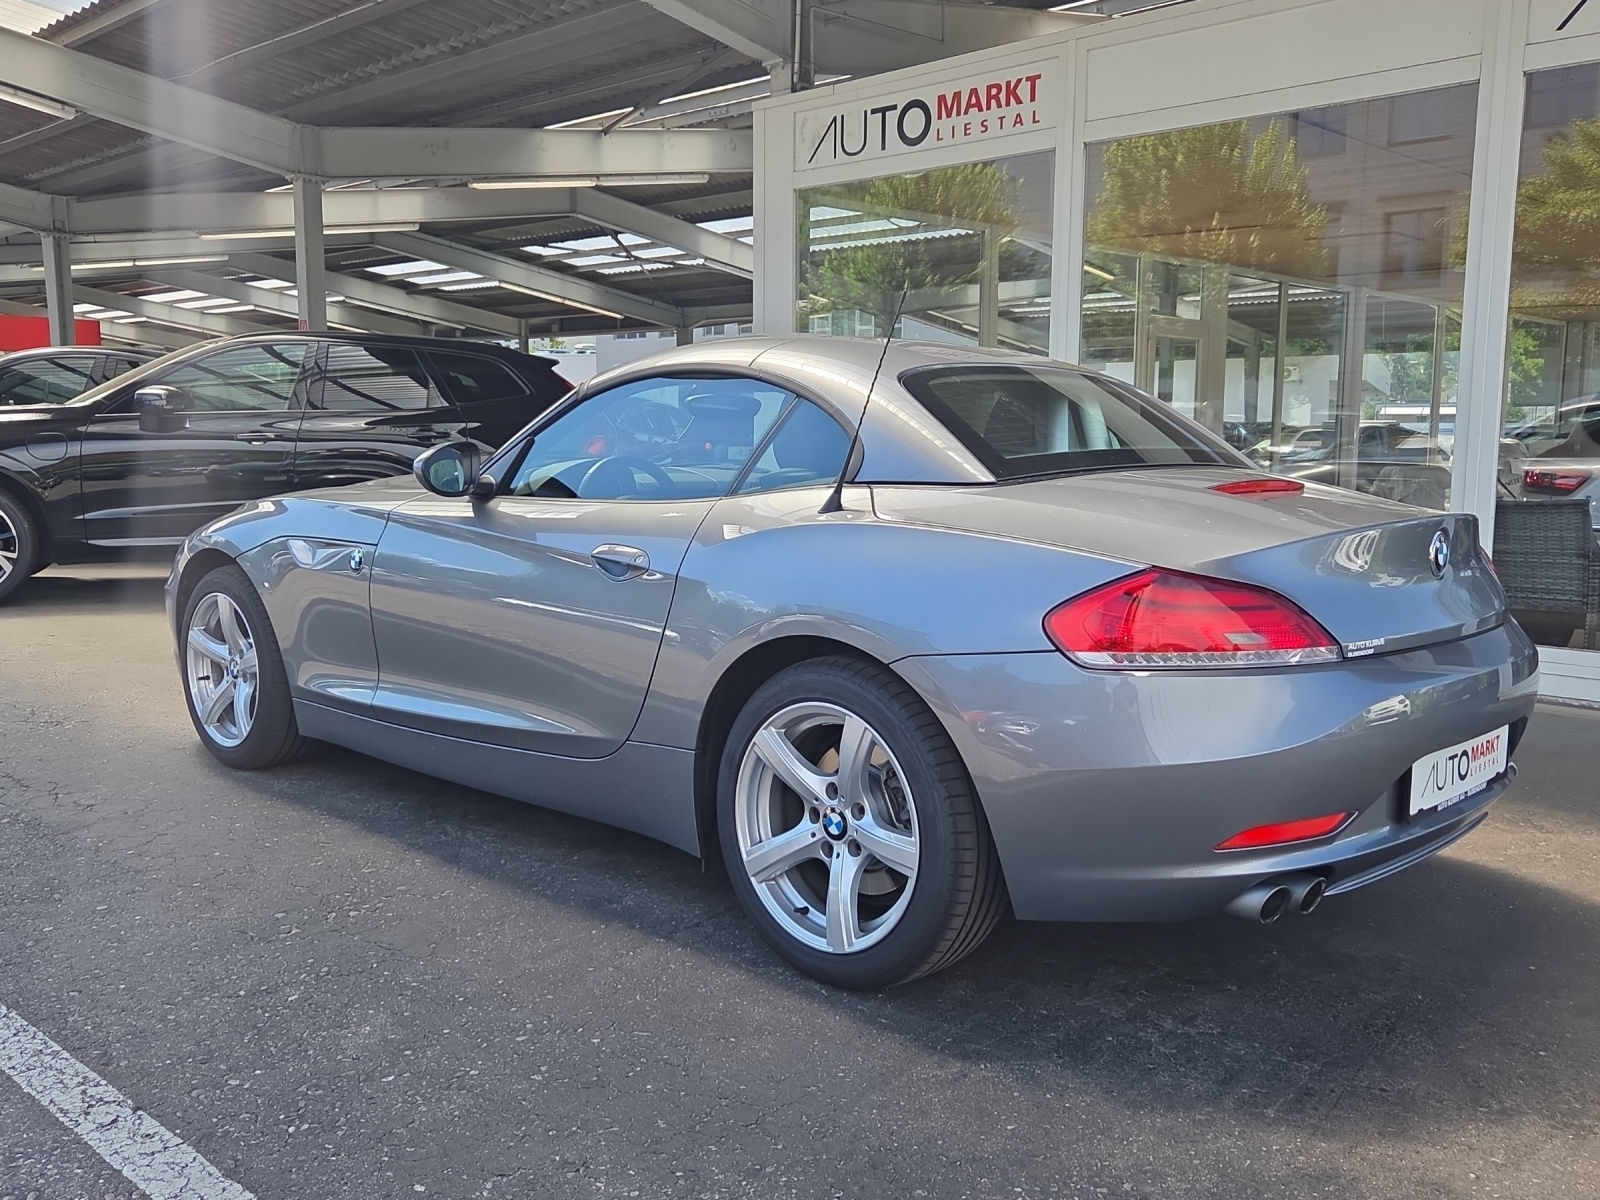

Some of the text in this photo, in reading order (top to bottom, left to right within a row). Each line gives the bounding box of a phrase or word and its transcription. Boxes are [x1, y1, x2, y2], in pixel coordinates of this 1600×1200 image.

[808, 73, 1042, 164] AUTO MARKT
[936, 109, 1041, 142] LIESTAL
[1348, 638, 1385, 650] AUTO KURVE
[1421, 734, 1500, 799] AUTO MARKT
[1470, 755, 1499, 777] LIESTAL
